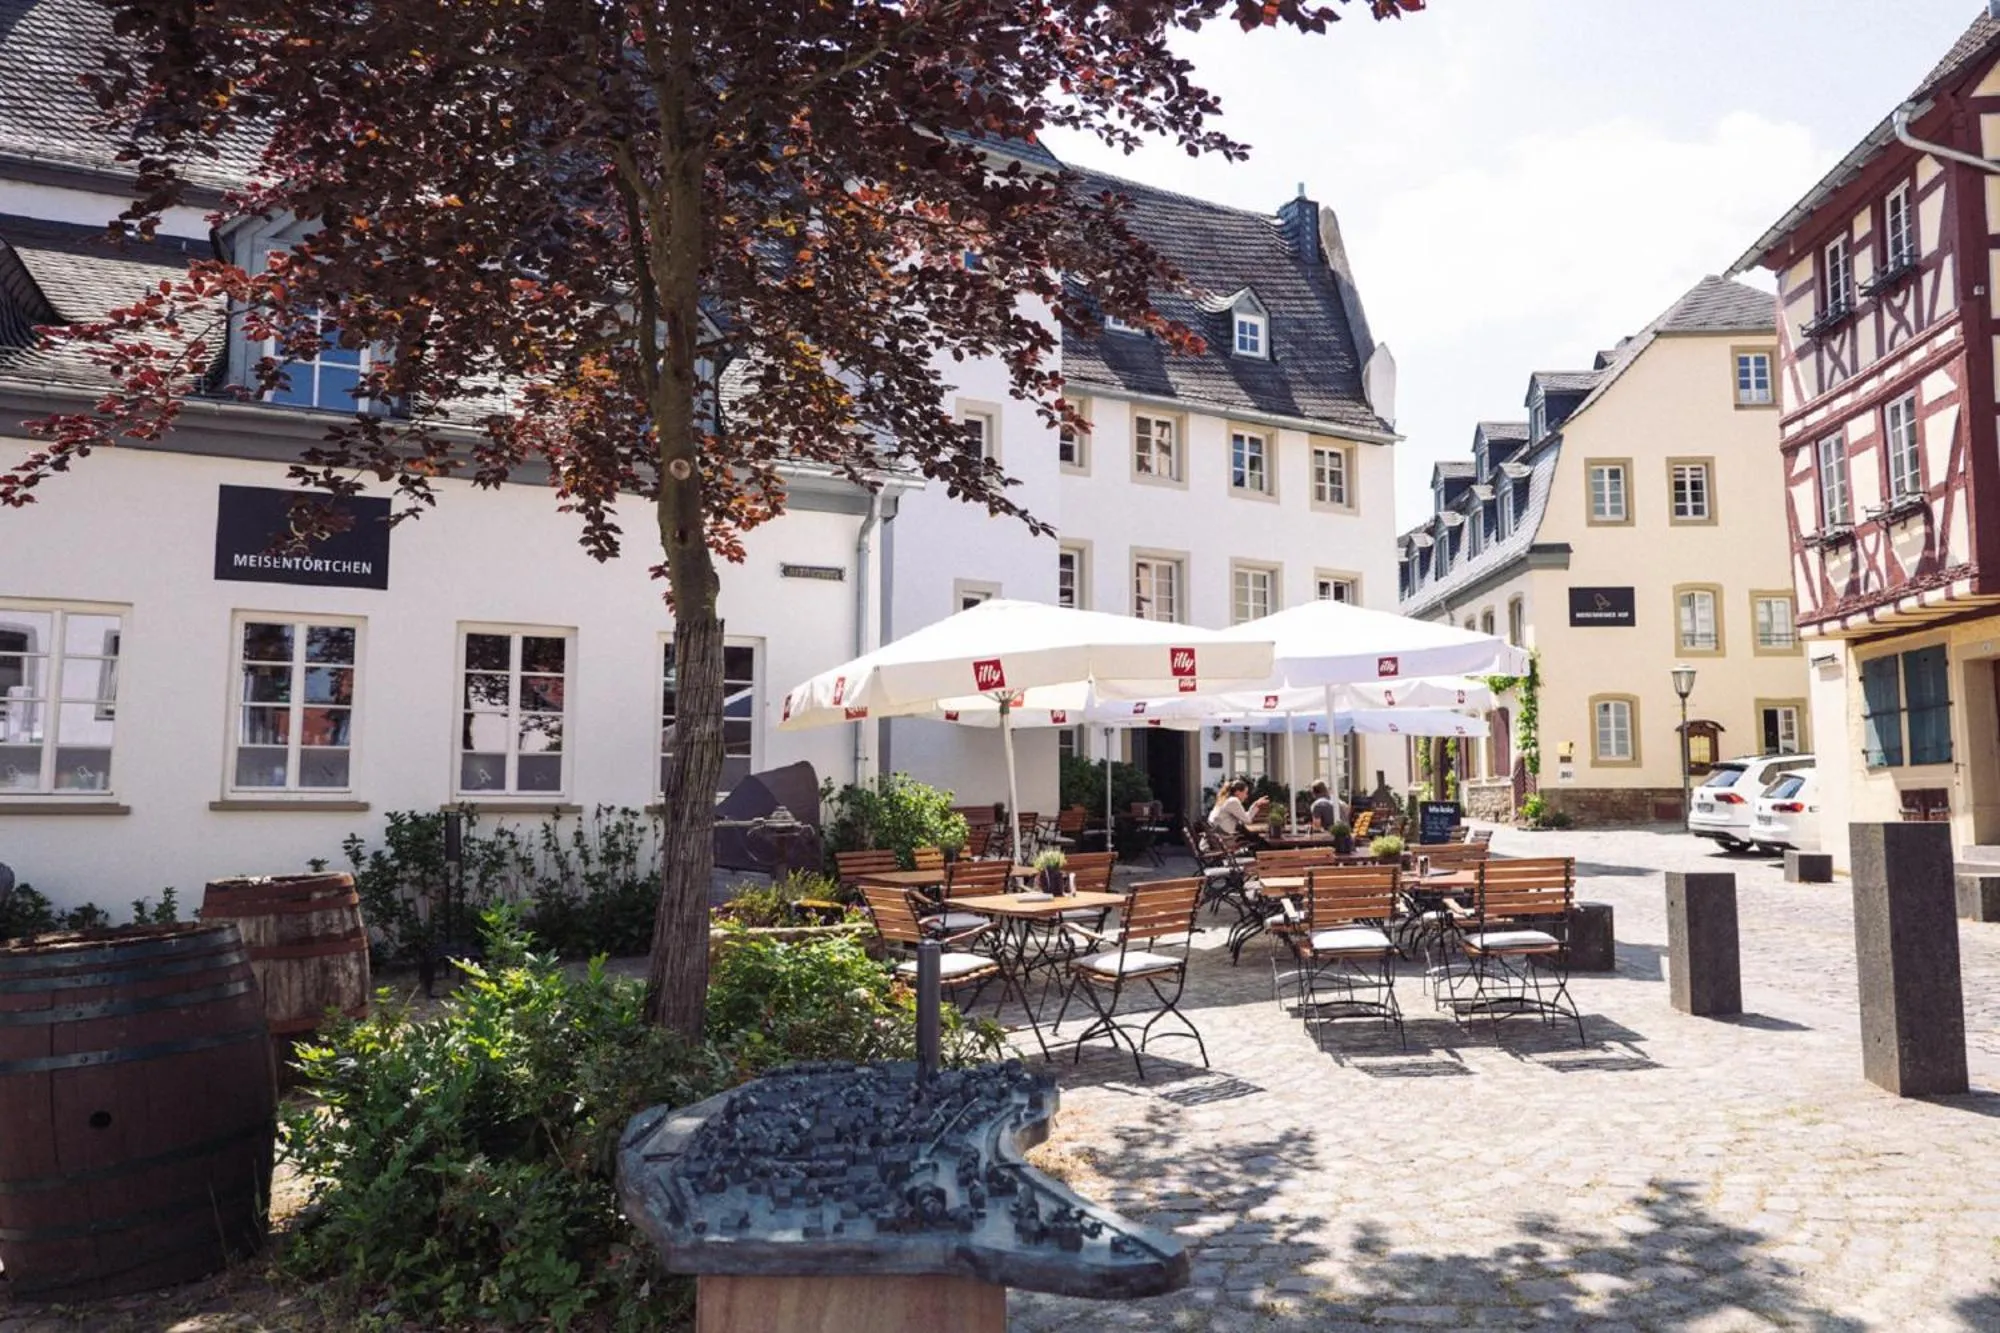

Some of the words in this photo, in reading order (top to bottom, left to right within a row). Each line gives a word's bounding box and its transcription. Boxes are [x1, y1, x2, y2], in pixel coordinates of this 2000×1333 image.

[233, 553, 373, 575] MEISENTÖRTCHEN
[1173, 651, 1195, 673] illy
[978, 664, 1001, 686] illy
